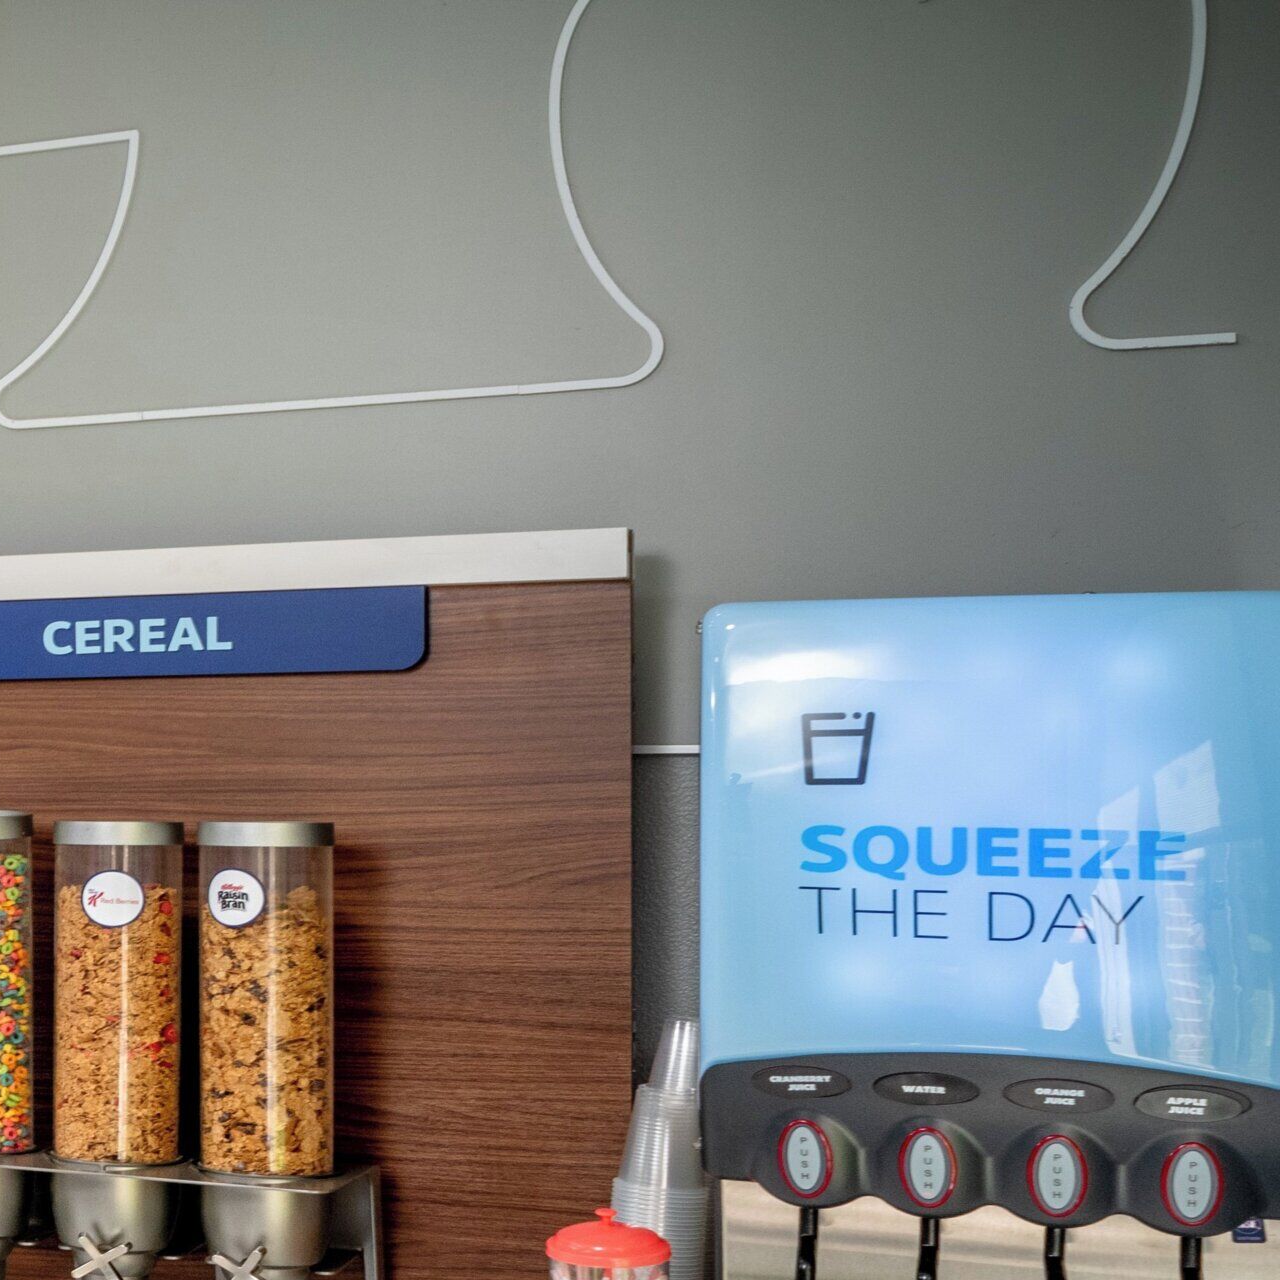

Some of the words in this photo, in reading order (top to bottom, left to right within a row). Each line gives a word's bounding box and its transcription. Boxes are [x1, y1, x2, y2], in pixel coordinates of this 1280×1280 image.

[42, 616, 234, 656] CEREAL
[799, 824, 1188, 881] SQUEEZE
[218, 890, 249, 902] Raisin
[221, 900, 246, 910] Bran
[798, 885, 949, 940] THE
[987, 889, 1145, 945] DAY
[769, 1075, 832, 1083] CRANBERRY
[787, 1083, 817, 1092] JUICE
[901, 1085, 947, 1095] WATER
[1034, 1087, 1086, 1098] ORANGE
[1044, 1096, 1076, 1106] JUICE
[1166, 1096, 1208, 1107] APPLE
[1168, 1105, 1205, 1115] JUICE
[799, 1136, 810, 1180] PUSH
[923, 1145, 934, 1189] PUSH
[1053, 1153, 1063, 1199] PUSH
[1188, 1161, 1198, 1208] PUSH
